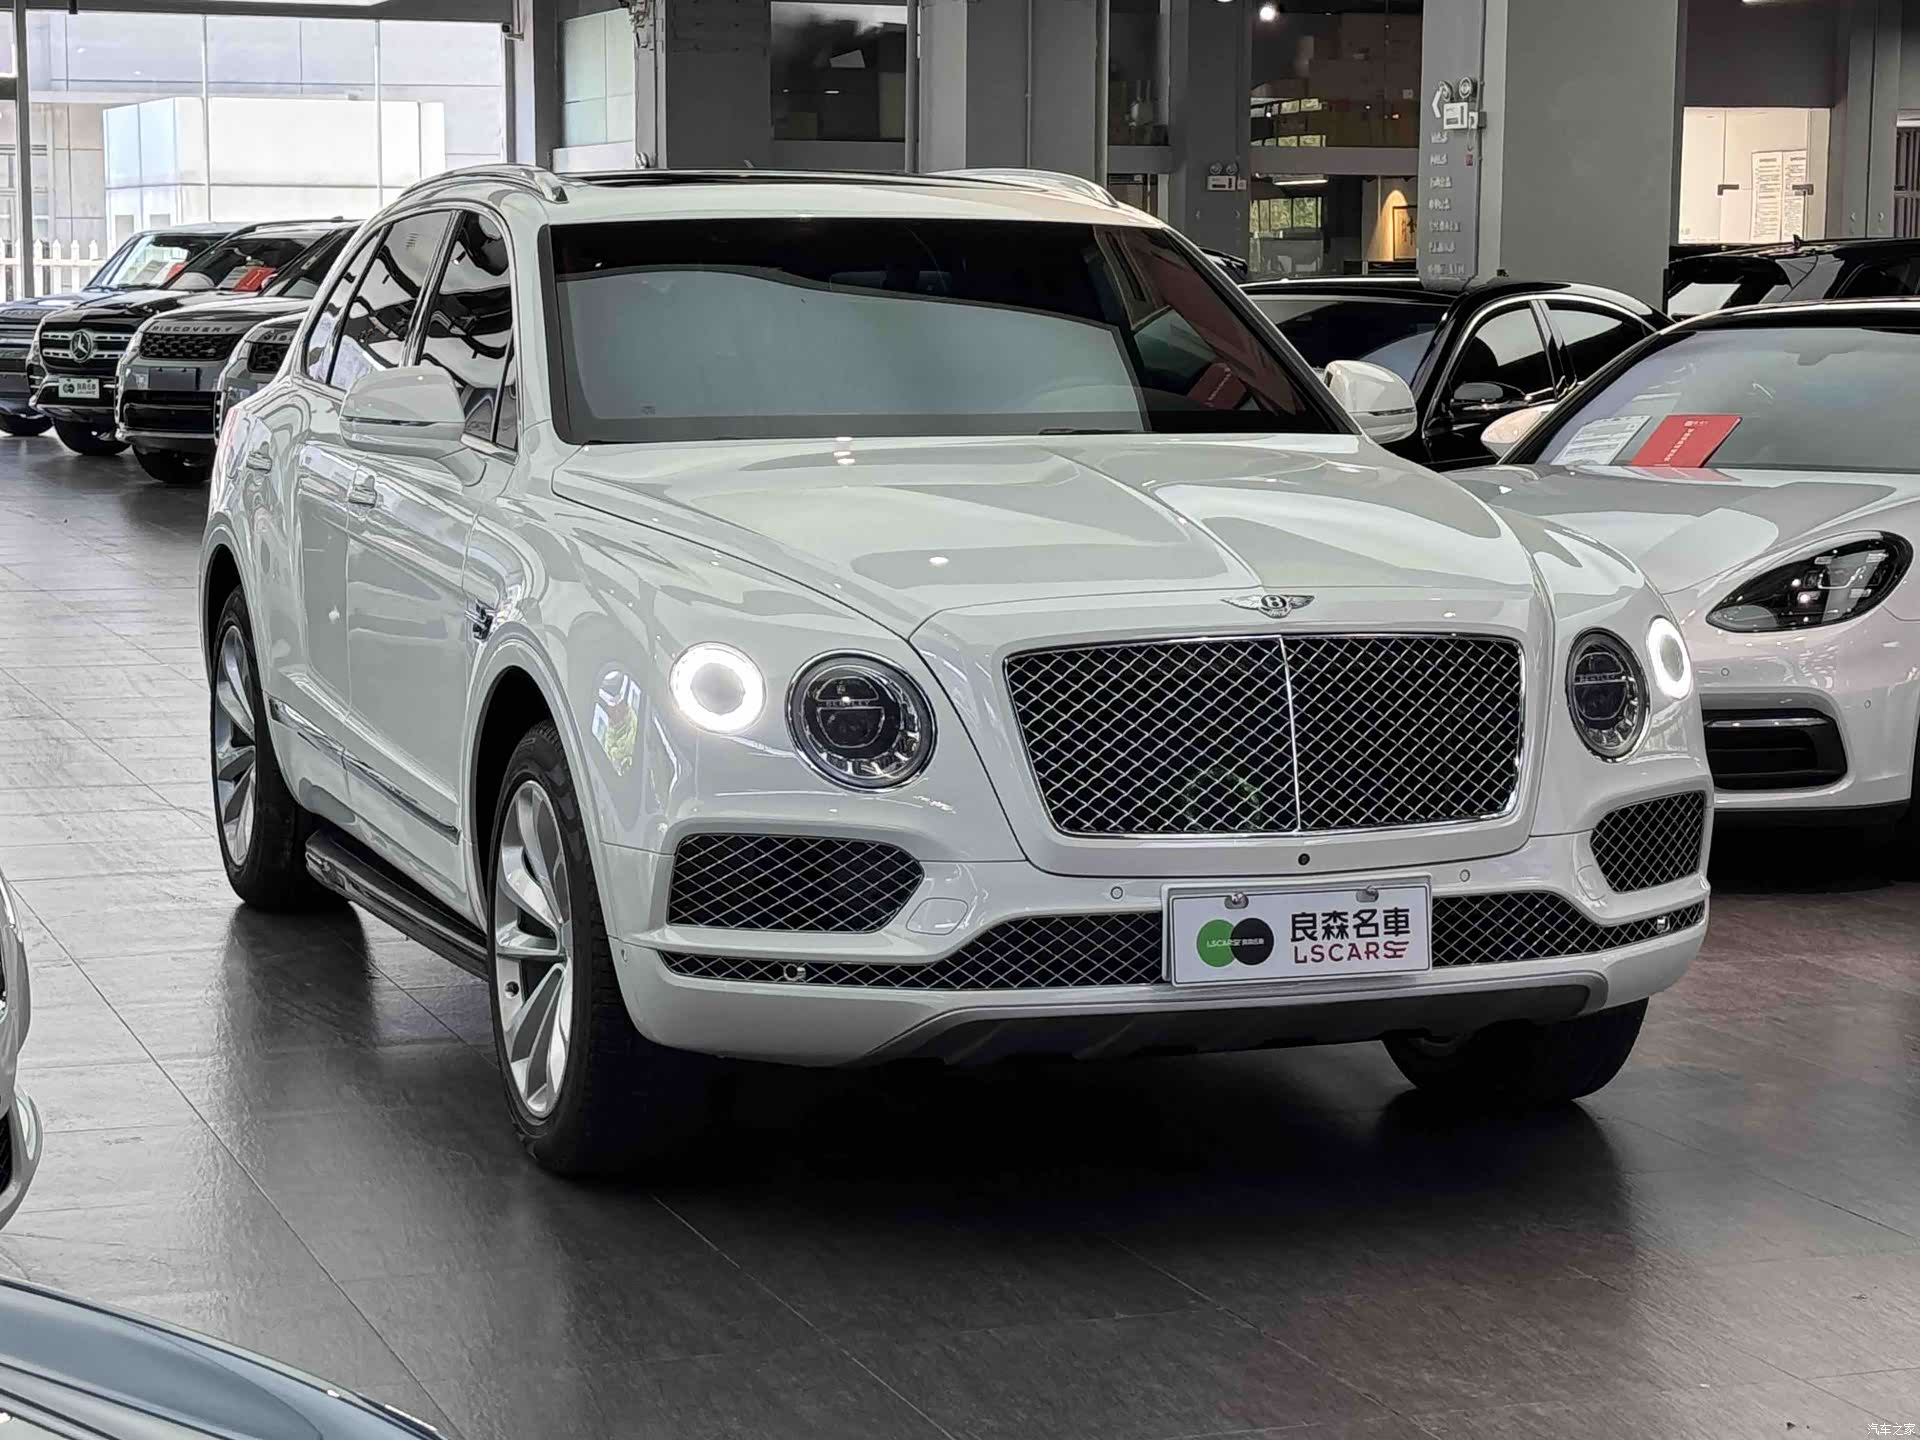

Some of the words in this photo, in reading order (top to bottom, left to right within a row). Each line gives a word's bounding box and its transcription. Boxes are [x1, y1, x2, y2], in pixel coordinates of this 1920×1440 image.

[152, 325, 233, 333] DISCOVERY
[1291, 907, 1410, 942] 良森名車
